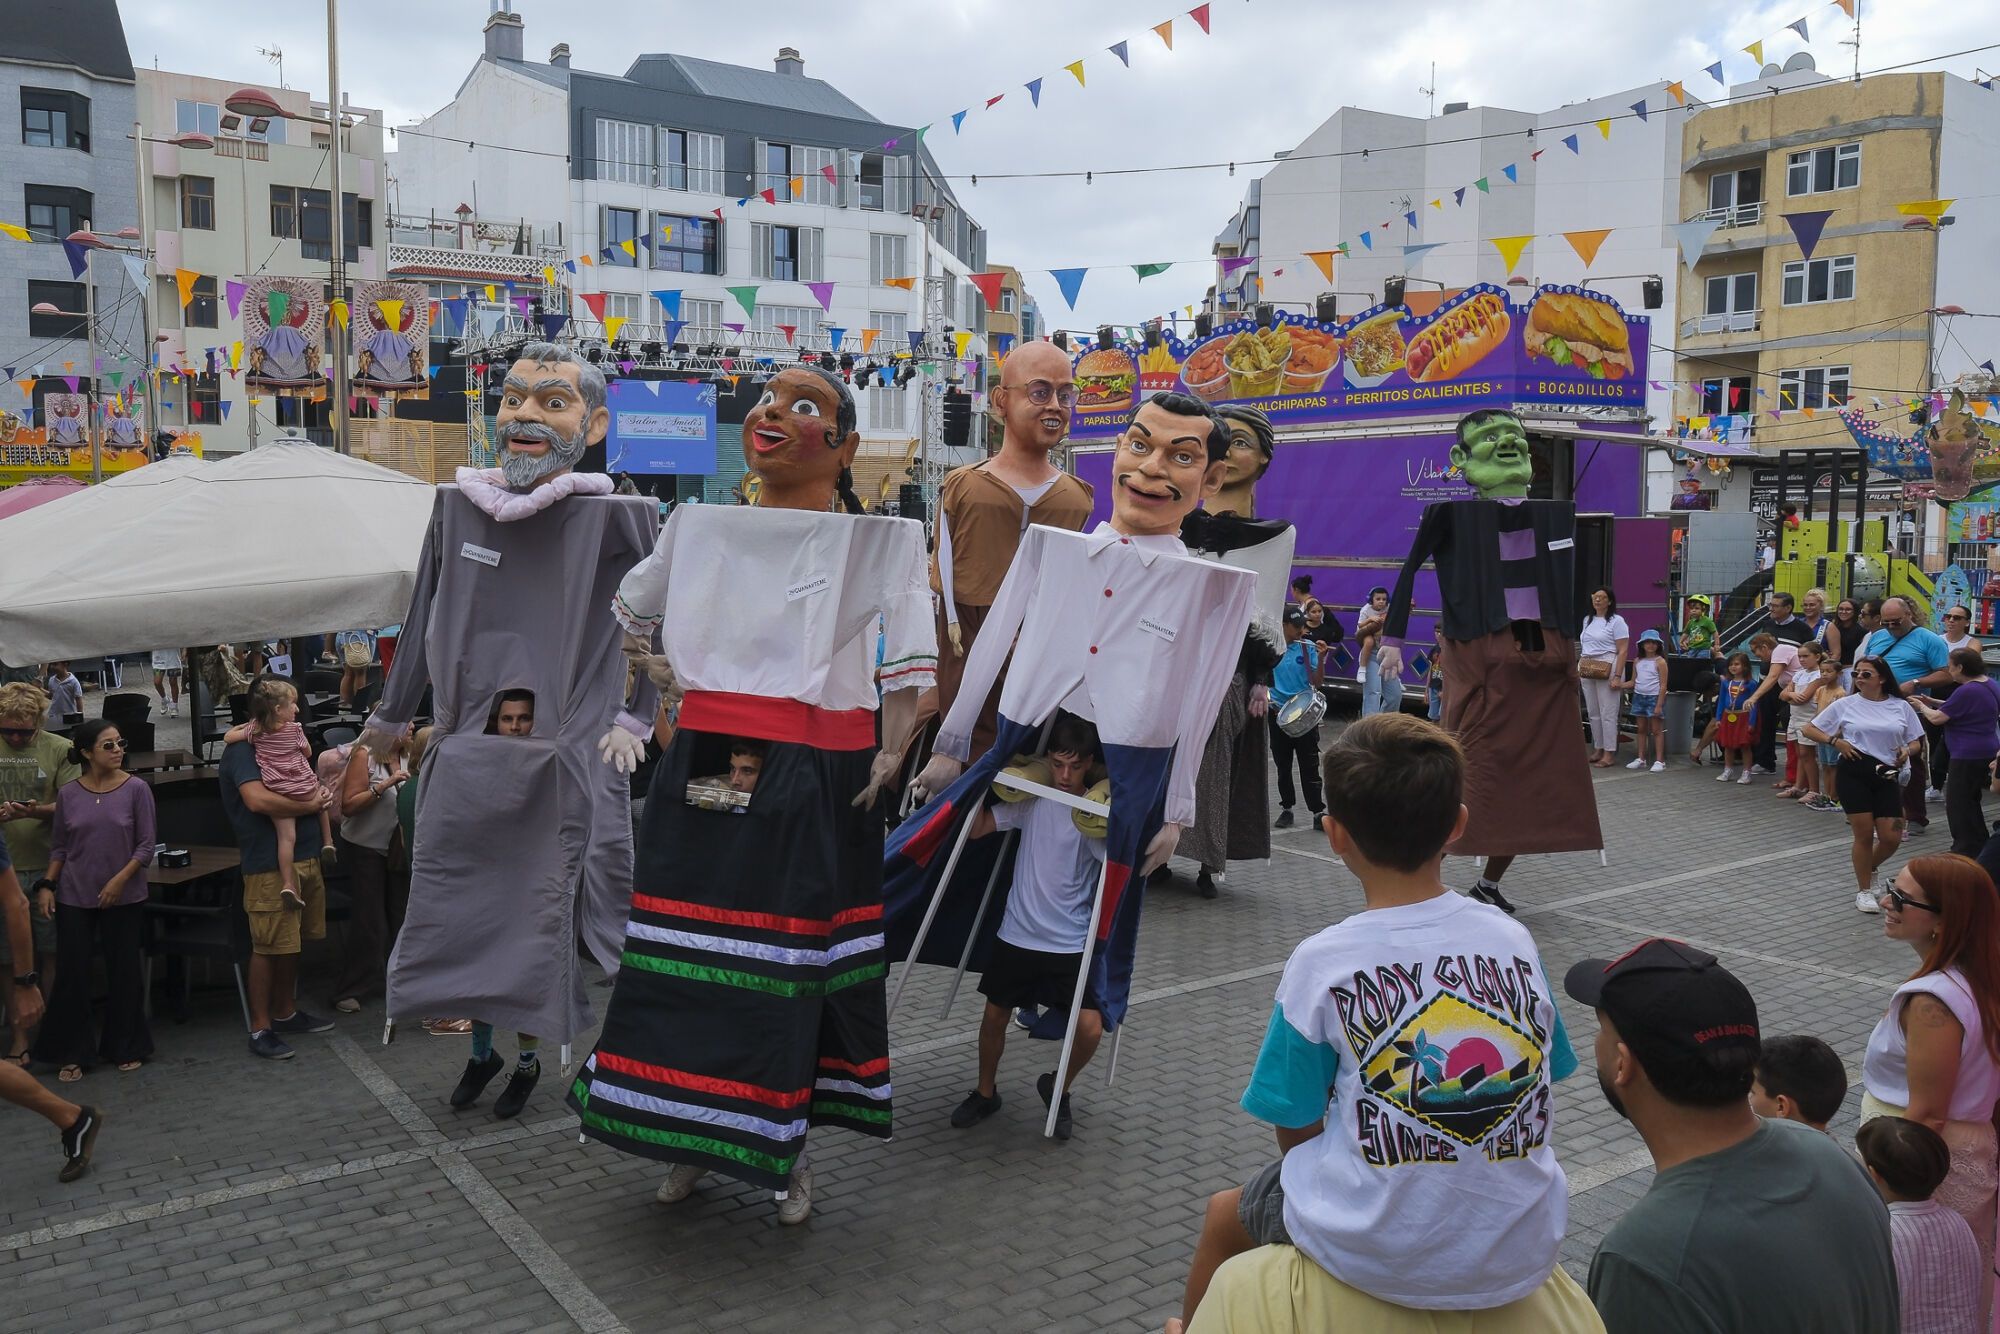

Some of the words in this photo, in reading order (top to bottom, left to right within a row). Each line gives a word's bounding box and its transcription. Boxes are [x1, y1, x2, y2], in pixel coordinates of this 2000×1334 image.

[1084, 416, 1111, 426] PAPAS
[1250, 396, 1327, 412] SALCHIPAPAS
[1345, 389, 1409, 405] PERRITOS
[1413, 382, 1491, 399] CALIENTES
[1539, 382, 1623, 396] BOCADILLOS
[627, 415, 657, 425] Salón
[1406, 457, 1463, 486] Vibras
[1329, 961, 1424, 1066] BODY
[1432, 954, 1548, 1049] GLOVE
[1356, 1098, 1460, 1168] SINCE
[1481, 1082, 1550, 1162] 1953
